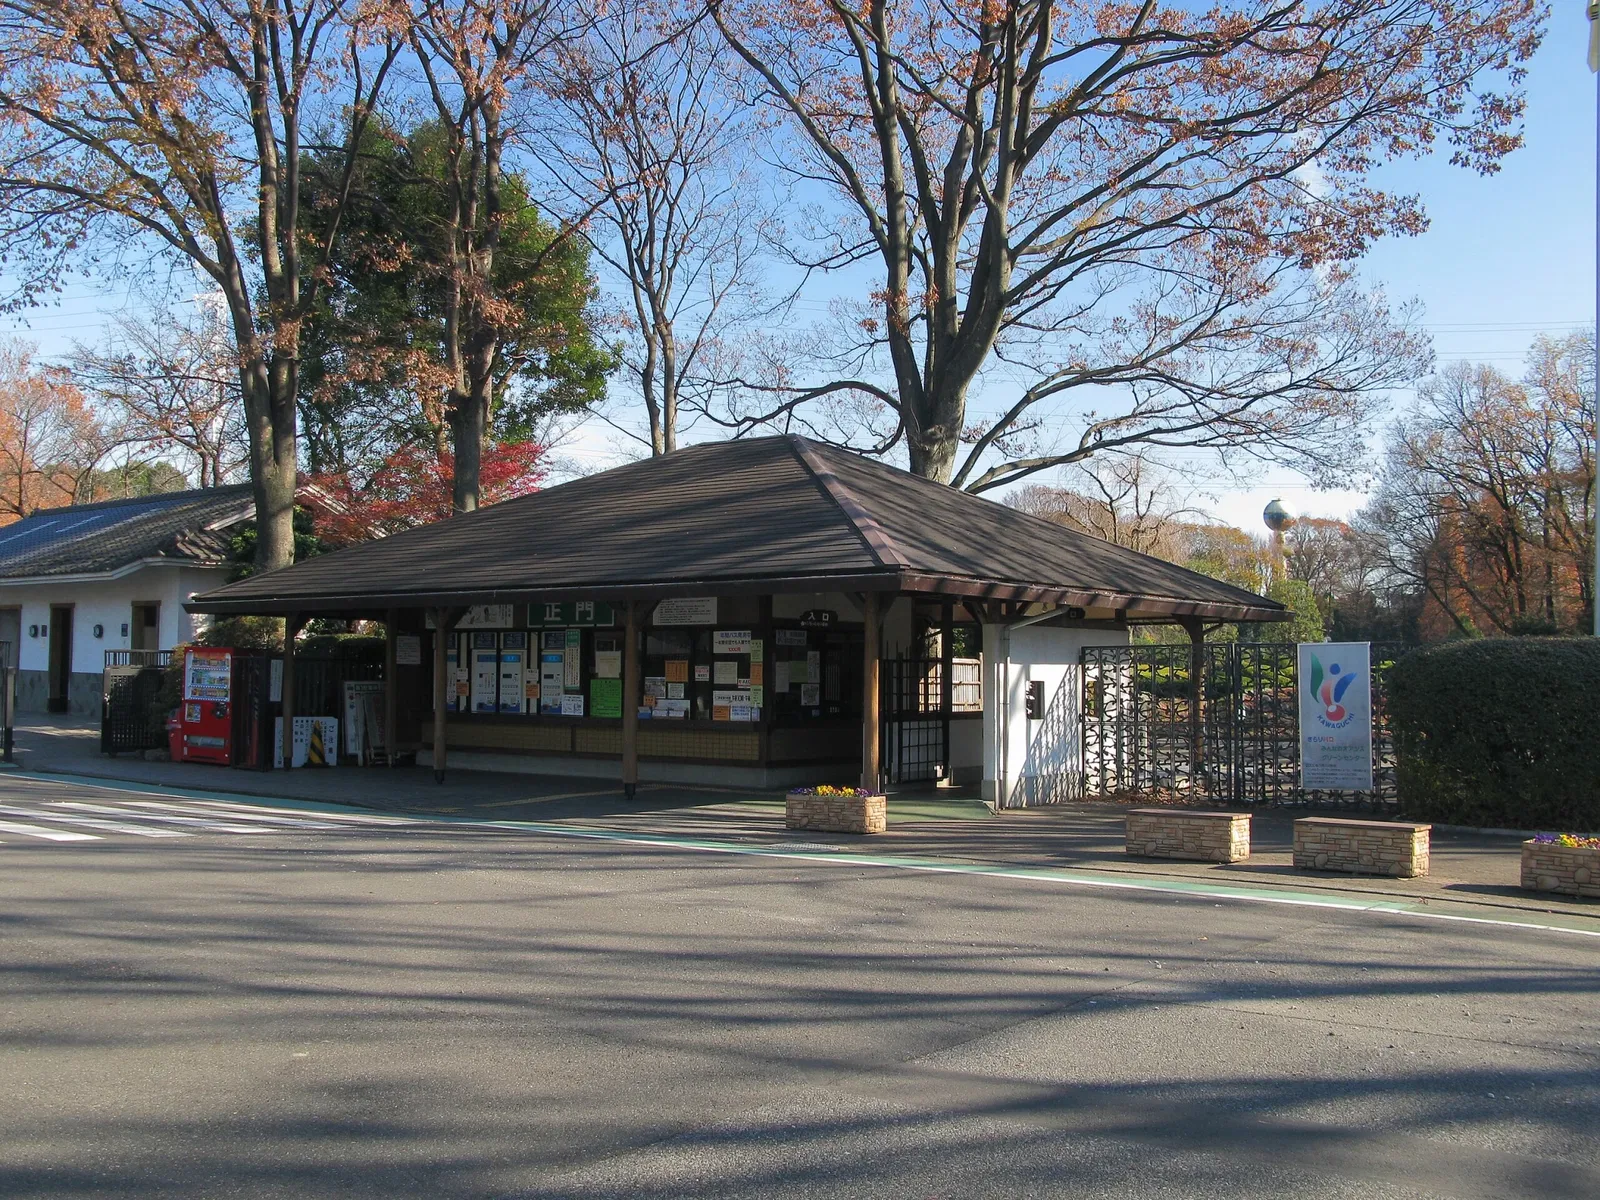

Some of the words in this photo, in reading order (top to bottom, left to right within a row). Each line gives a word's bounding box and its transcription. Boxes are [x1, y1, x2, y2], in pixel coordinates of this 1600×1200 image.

[543, 601, 594, 622] 正門
[807, 611, 830, 622] 入口
[1316, 712, 1355, 729] KAWAGUCHI
